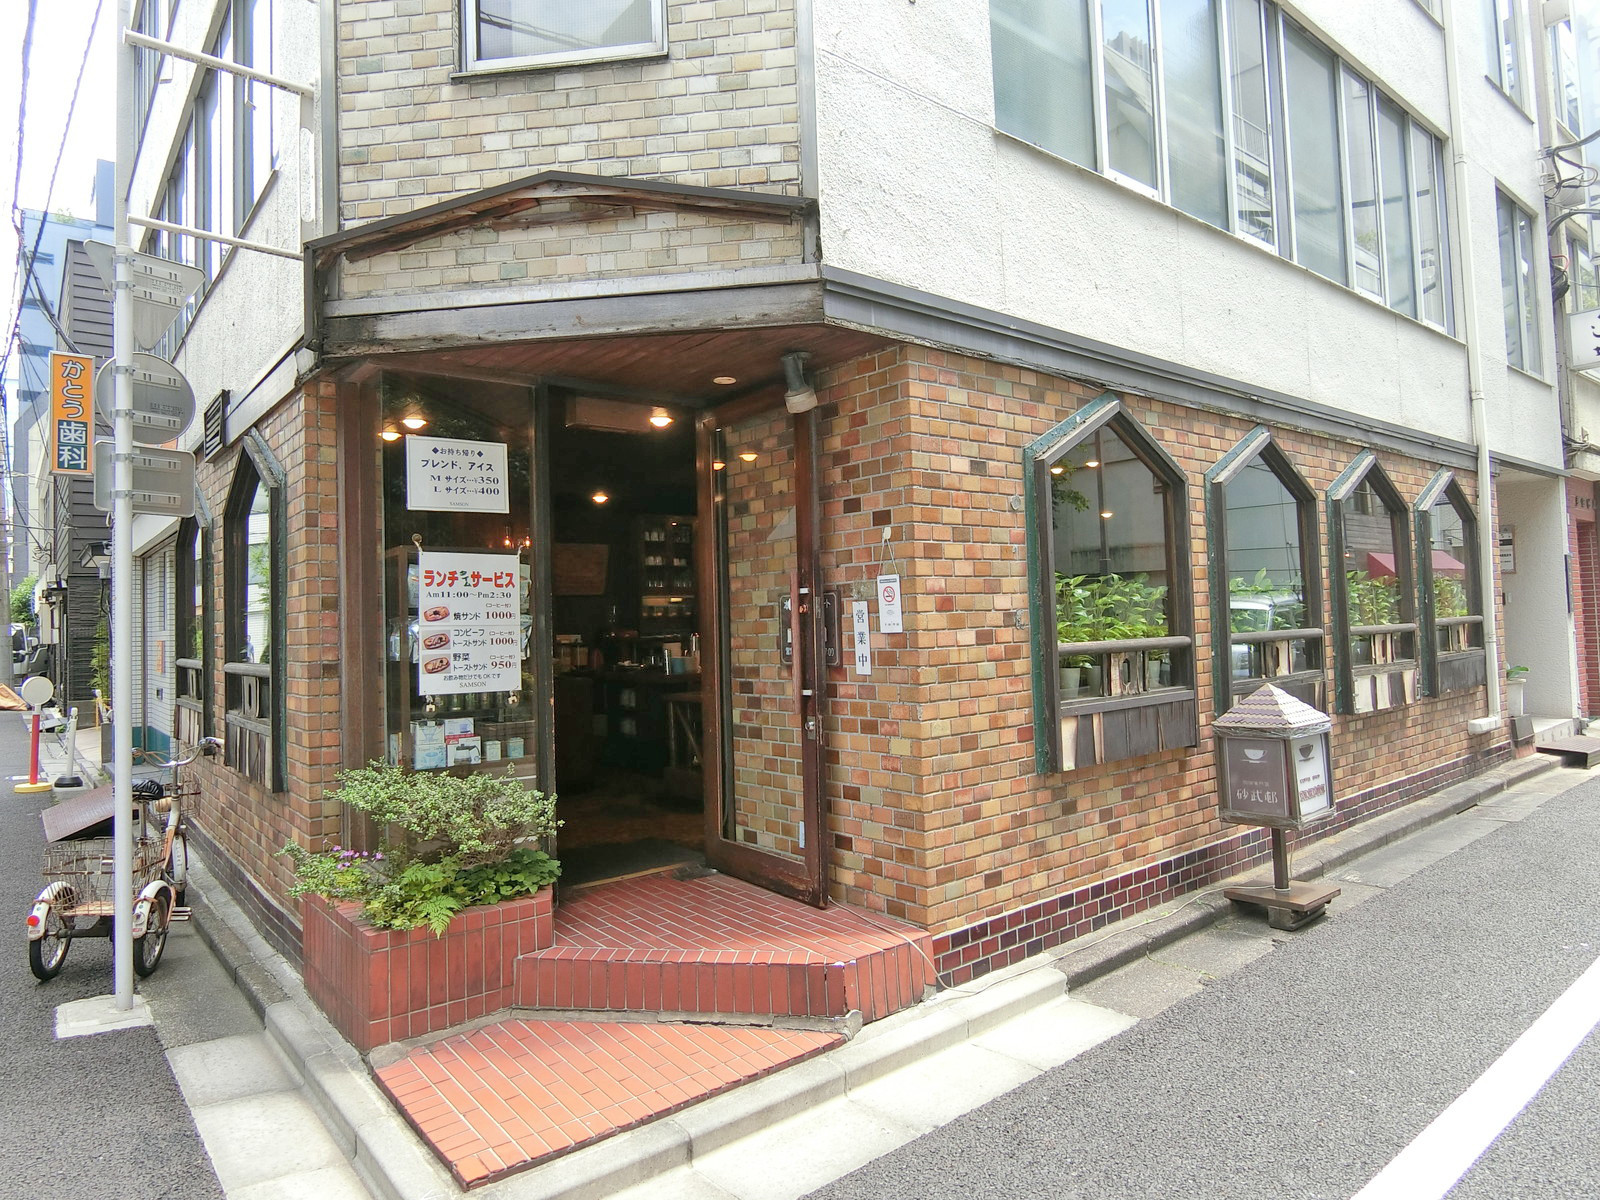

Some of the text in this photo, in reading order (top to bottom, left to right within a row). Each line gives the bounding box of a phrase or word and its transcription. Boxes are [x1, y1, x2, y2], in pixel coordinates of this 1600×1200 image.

[58, 359, 87, 470] かとう歯科
[440, 448, 476, 457] お持ち帰り
[453, 612, 480, 620] 焼サンド
[856, 609, 868, 667] 営業中
[452, 639, 487, 647] トーストサンド
[453, 653, 470, 661] 野菜
[453, 663, 488, 671] トーストサンド
